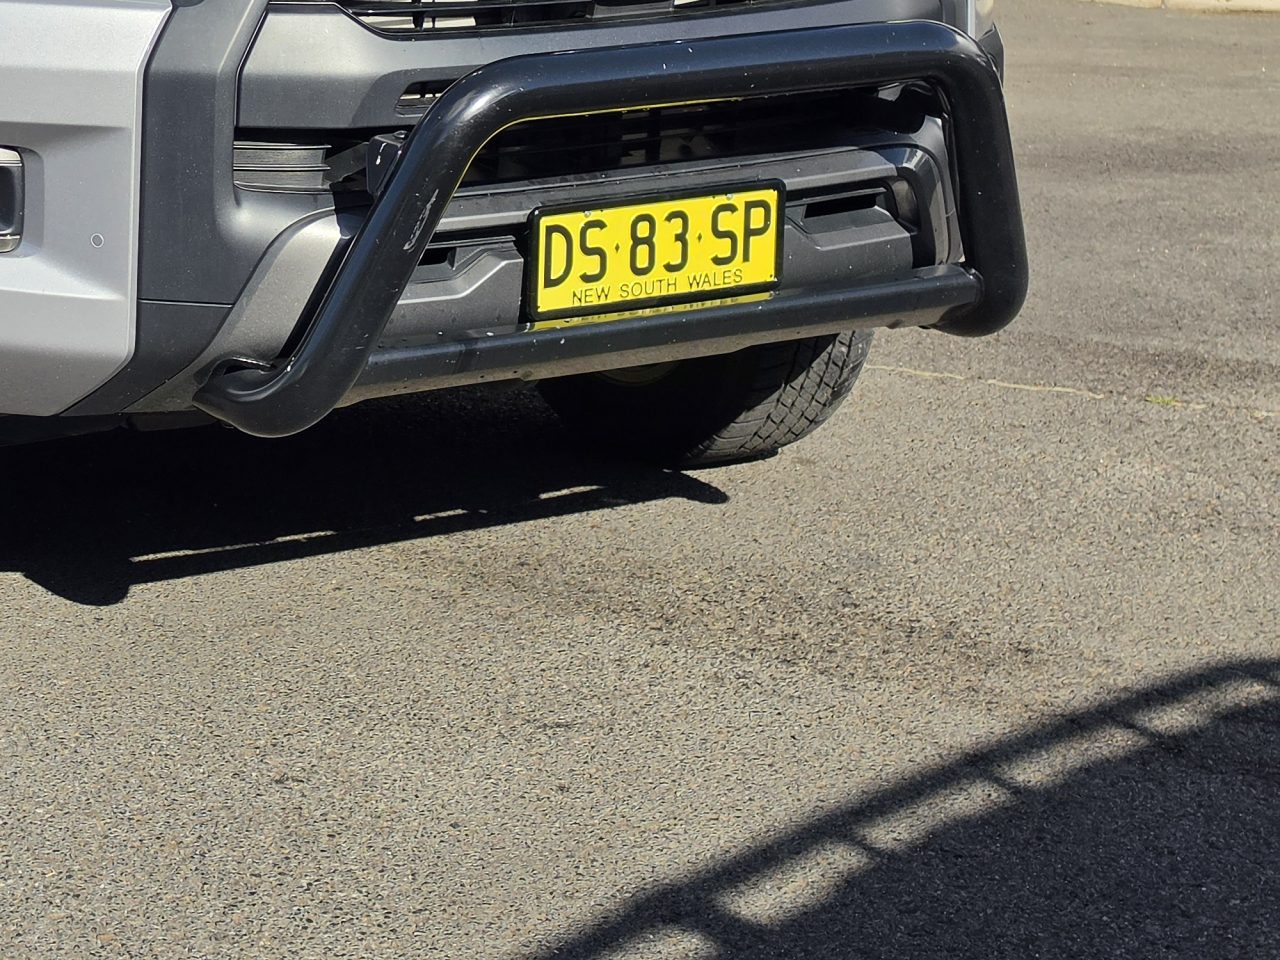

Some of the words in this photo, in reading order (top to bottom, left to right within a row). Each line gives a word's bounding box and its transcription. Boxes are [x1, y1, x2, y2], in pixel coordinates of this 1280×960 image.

[543, 219, 608, 289] DS
[629, 209, 689, 276] 83
[710, 199, 772, 266] SP
[572, 286, 611, 305] NEW
[619, 278, 677, 298] SOUTH
[687, 269, 743, 289] WALES
